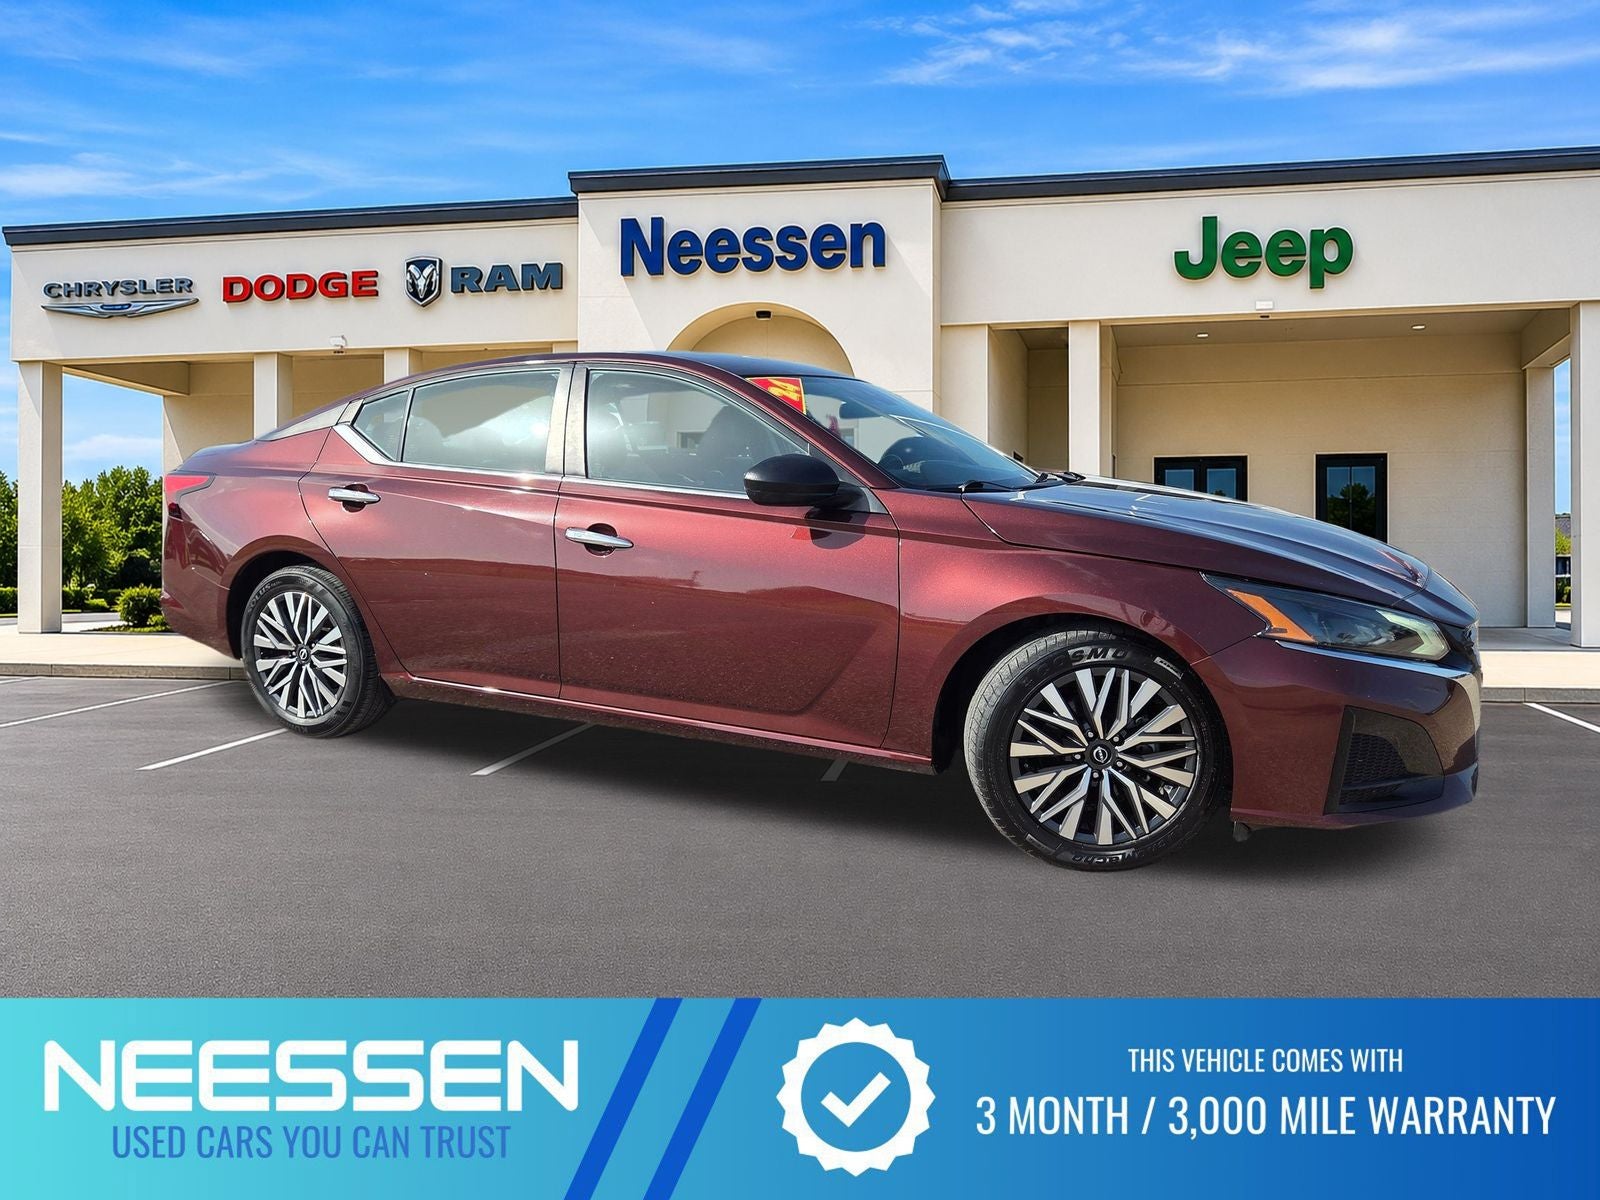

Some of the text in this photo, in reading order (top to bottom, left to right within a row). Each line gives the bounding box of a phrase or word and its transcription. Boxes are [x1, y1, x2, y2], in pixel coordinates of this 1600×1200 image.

[620, 215, 887, 277] Neessen
[1173, 215, 1355, 289] Jeep
[43, 277, 194, 299] CHRYSLER
[222, 270, 379, 303] DODGE
[450, 262, 564, 294] RAM
